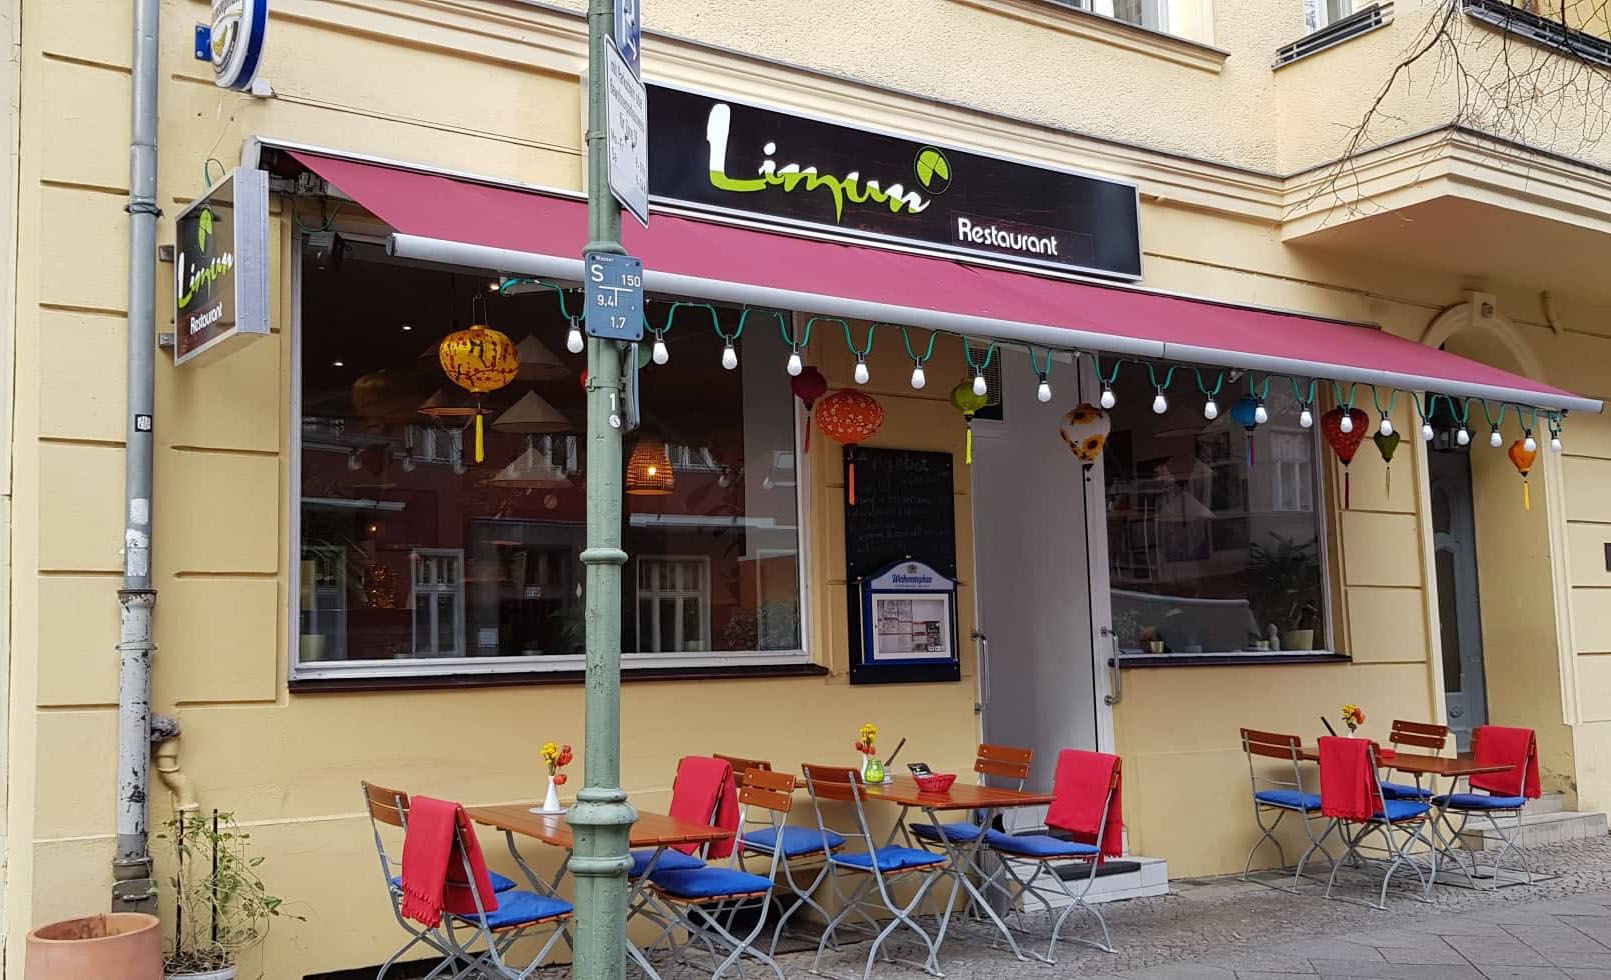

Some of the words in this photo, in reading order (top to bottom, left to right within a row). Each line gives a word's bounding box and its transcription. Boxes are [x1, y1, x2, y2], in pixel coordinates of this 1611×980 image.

[706, 103, 931, 224] Limun
[957, 217, 1058, 256] Restaurant
[591, 265, 604, 282] S
[621, 275, 641, 287] 150
[190, 302, 223, 334] Restaurant
